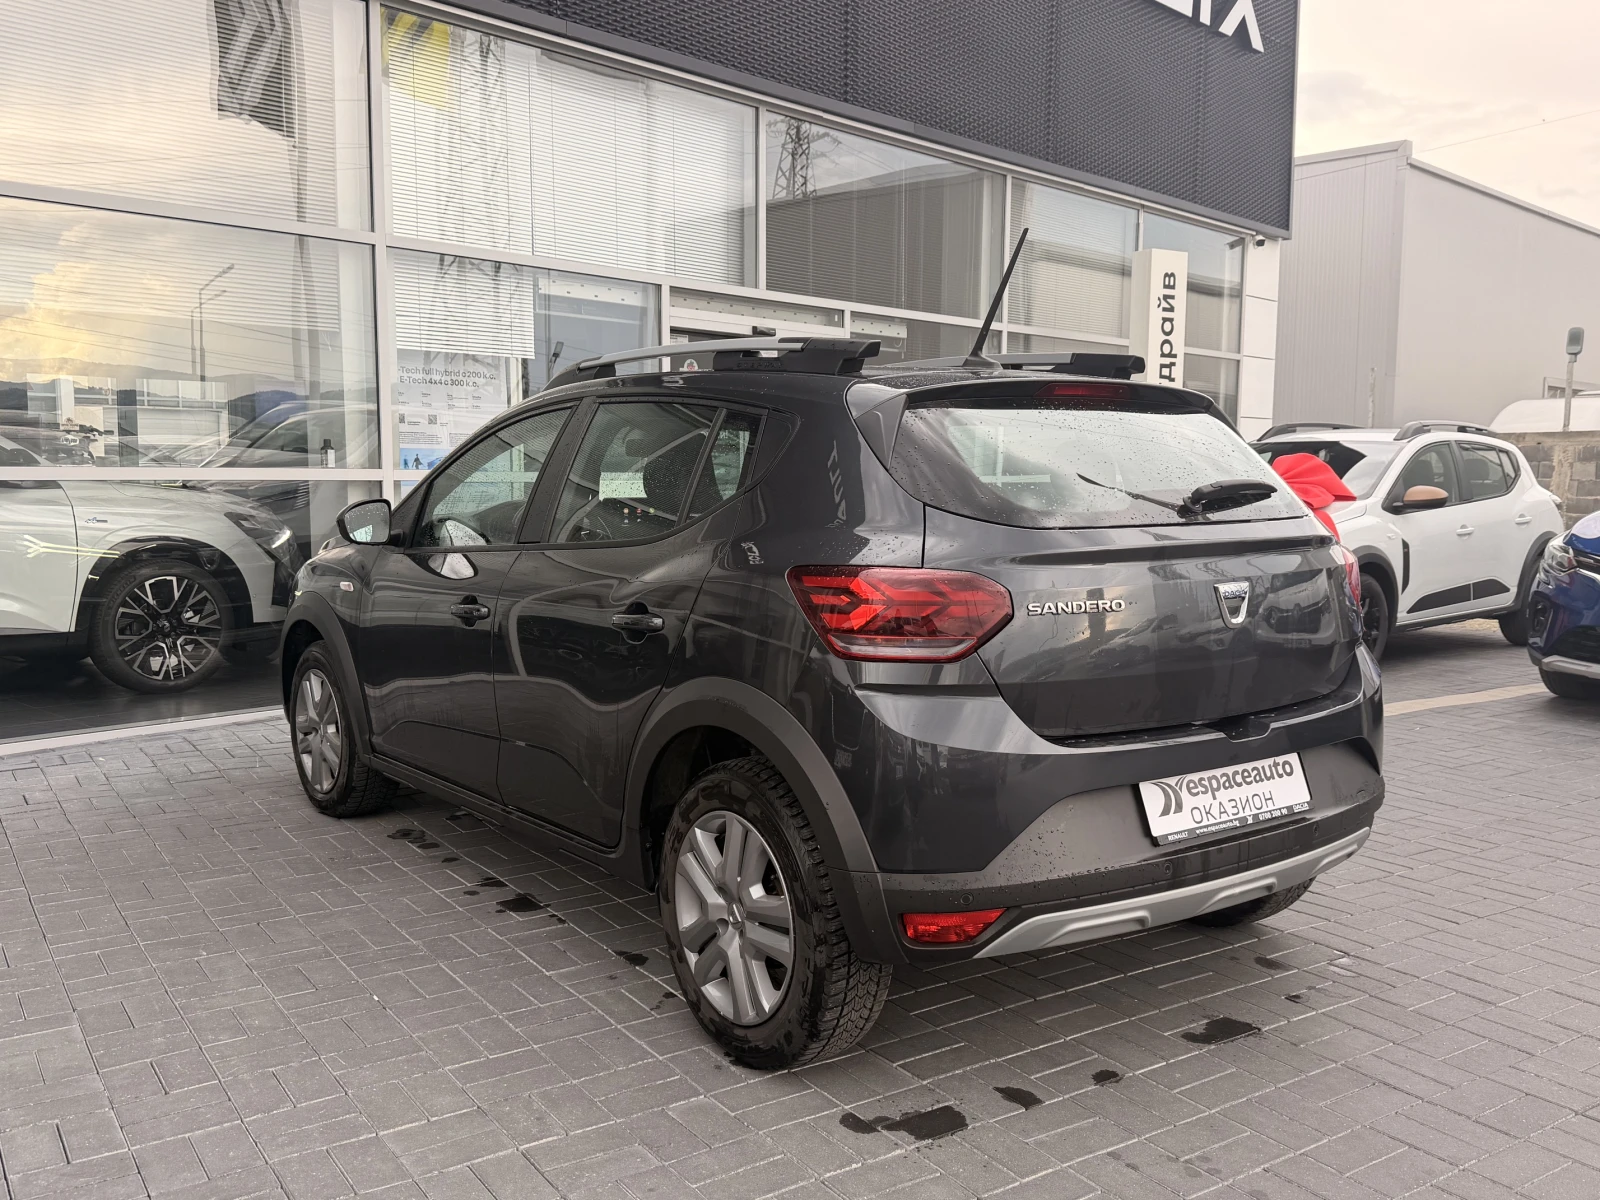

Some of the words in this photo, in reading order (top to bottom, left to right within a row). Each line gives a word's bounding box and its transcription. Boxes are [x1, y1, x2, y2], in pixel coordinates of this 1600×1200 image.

[399, 375, 428, 385] E-Tech
[428, 377, 443, 386] 4x4
[449, 379, 465, 387] 300
[422, 367, 435, 376] full
[435, 367, 460, 378] hybrid
[467, 371, 482, 379] 200
[1027, 599, 1126, 616] SANDERO
[1185, 757, 1294, 800] espaceauto
[1190, 790, 1276, 824] ОКАЗИОН
[1167, 831, 1189, 842] RENAULT
[1258, 812, 1272, 821] 0700
[1293, 802, 1309, 810] DACIA
